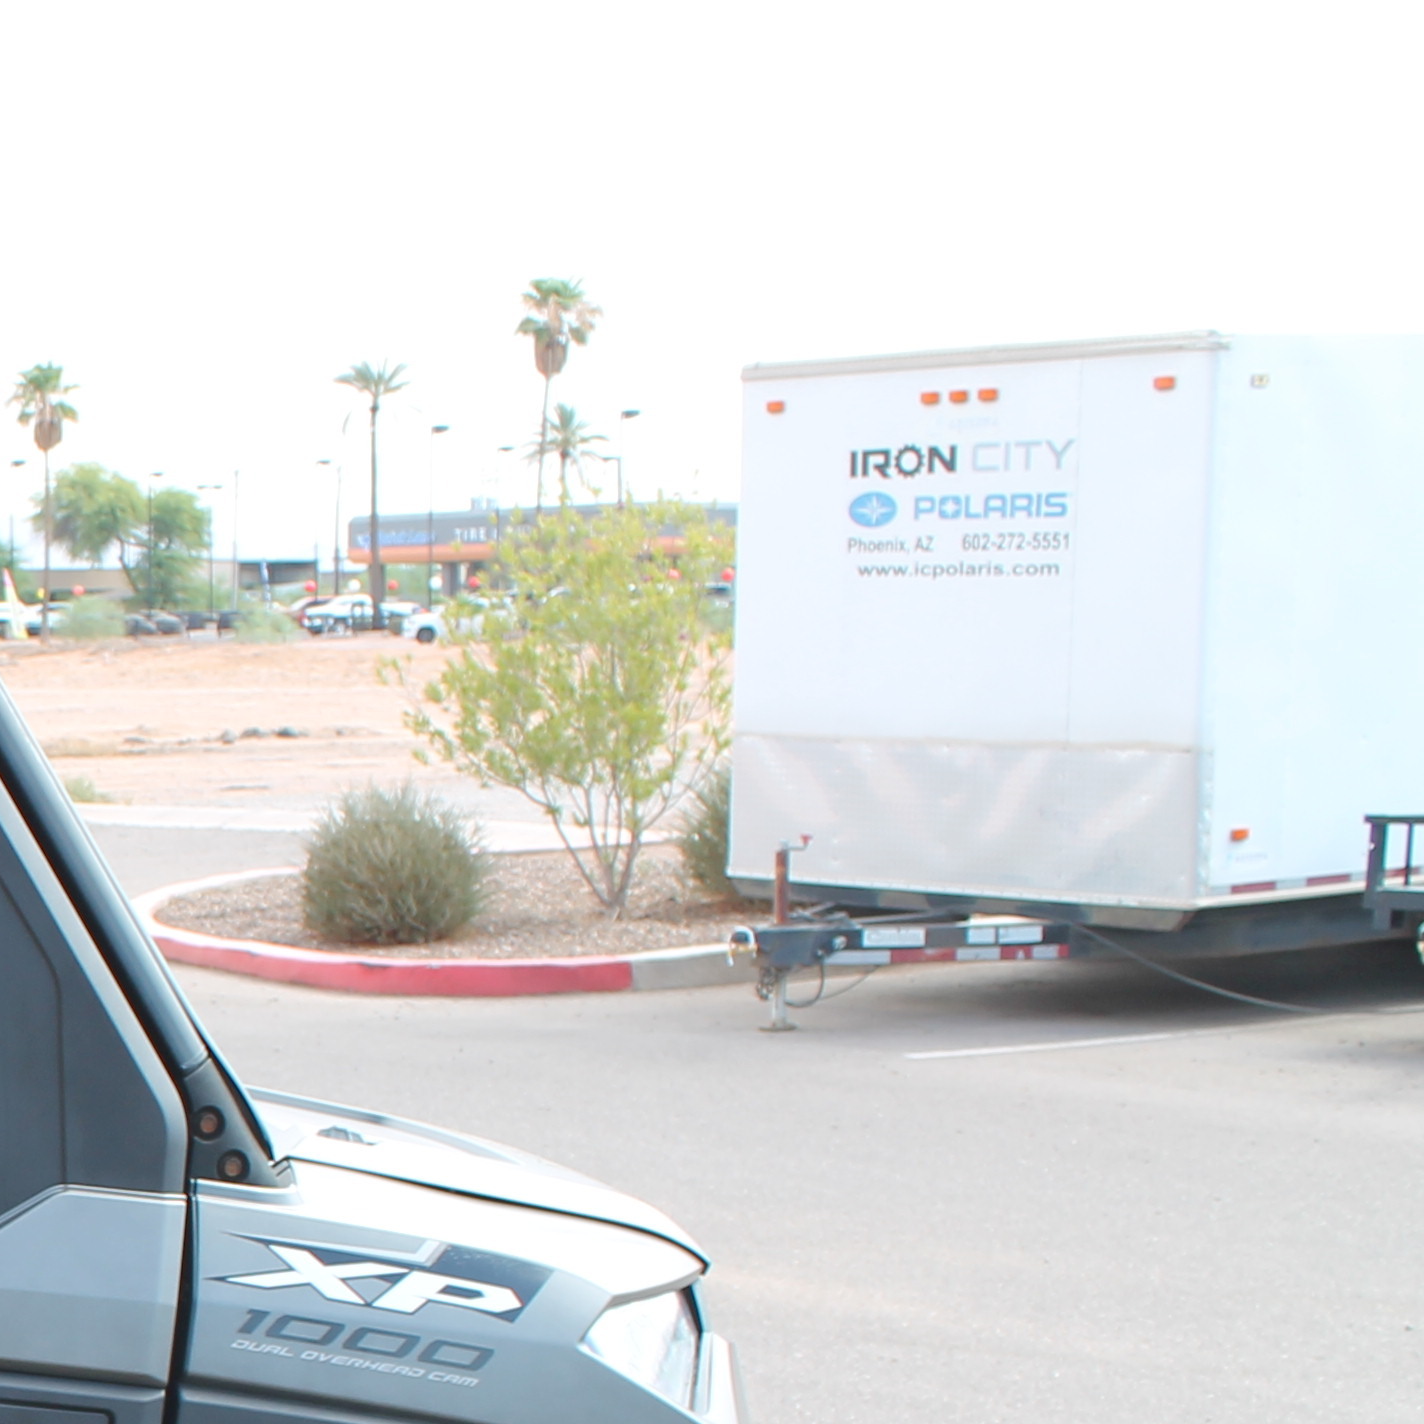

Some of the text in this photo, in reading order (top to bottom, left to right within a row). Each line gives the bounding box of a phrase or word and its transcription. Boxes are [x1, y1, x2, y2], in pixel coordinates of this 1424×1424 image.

[849, 438, 1076, 479] IRON CITY
[913, 492, 1069, 520] POLARIS
[847, 532, 1071, 555] Phoenix, AZ 602-272-5551
[857, 559, 1060, 580] www.icpolaris.com
[218, 1243, 526, 1316] XP
[236, 1308, 496, 1372] 1000
[229, 1339, 481, 1388] DUAL OVERHEAD CAM
